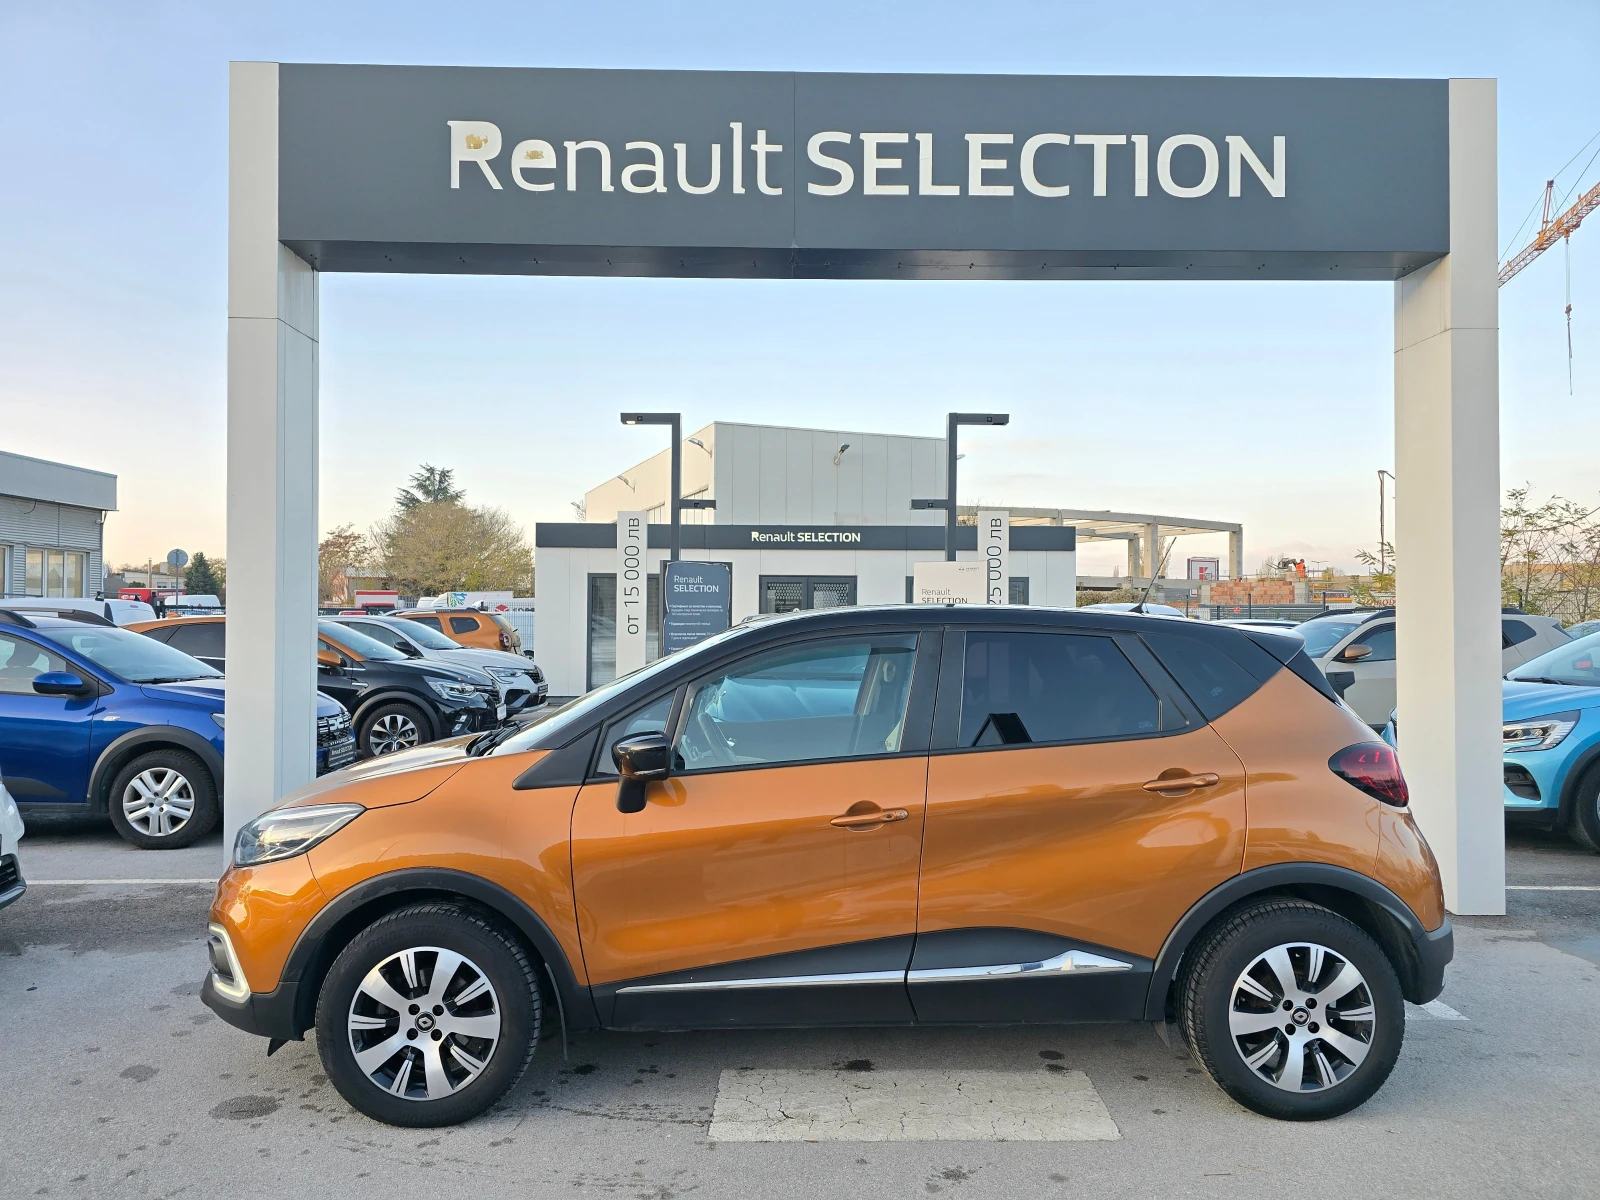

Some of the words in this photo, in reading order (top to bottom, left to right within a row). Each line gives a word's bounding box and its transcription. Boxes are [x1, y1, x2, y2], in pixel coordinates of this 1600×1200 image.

[447, 120, 783, 195] Renault
[807, 131, 1286, 198] SELECTION
[751, 531, 795, 542] Renault
[797, 532, 861, 542] SELECTION
[624, 545, 640, 581] 000
[673, 575, 703, 584] Renault
[673, 584, 719, 593] SELECTION
[921, 588, 951, 596] Renault
[624, 586, 640, 608] 15
